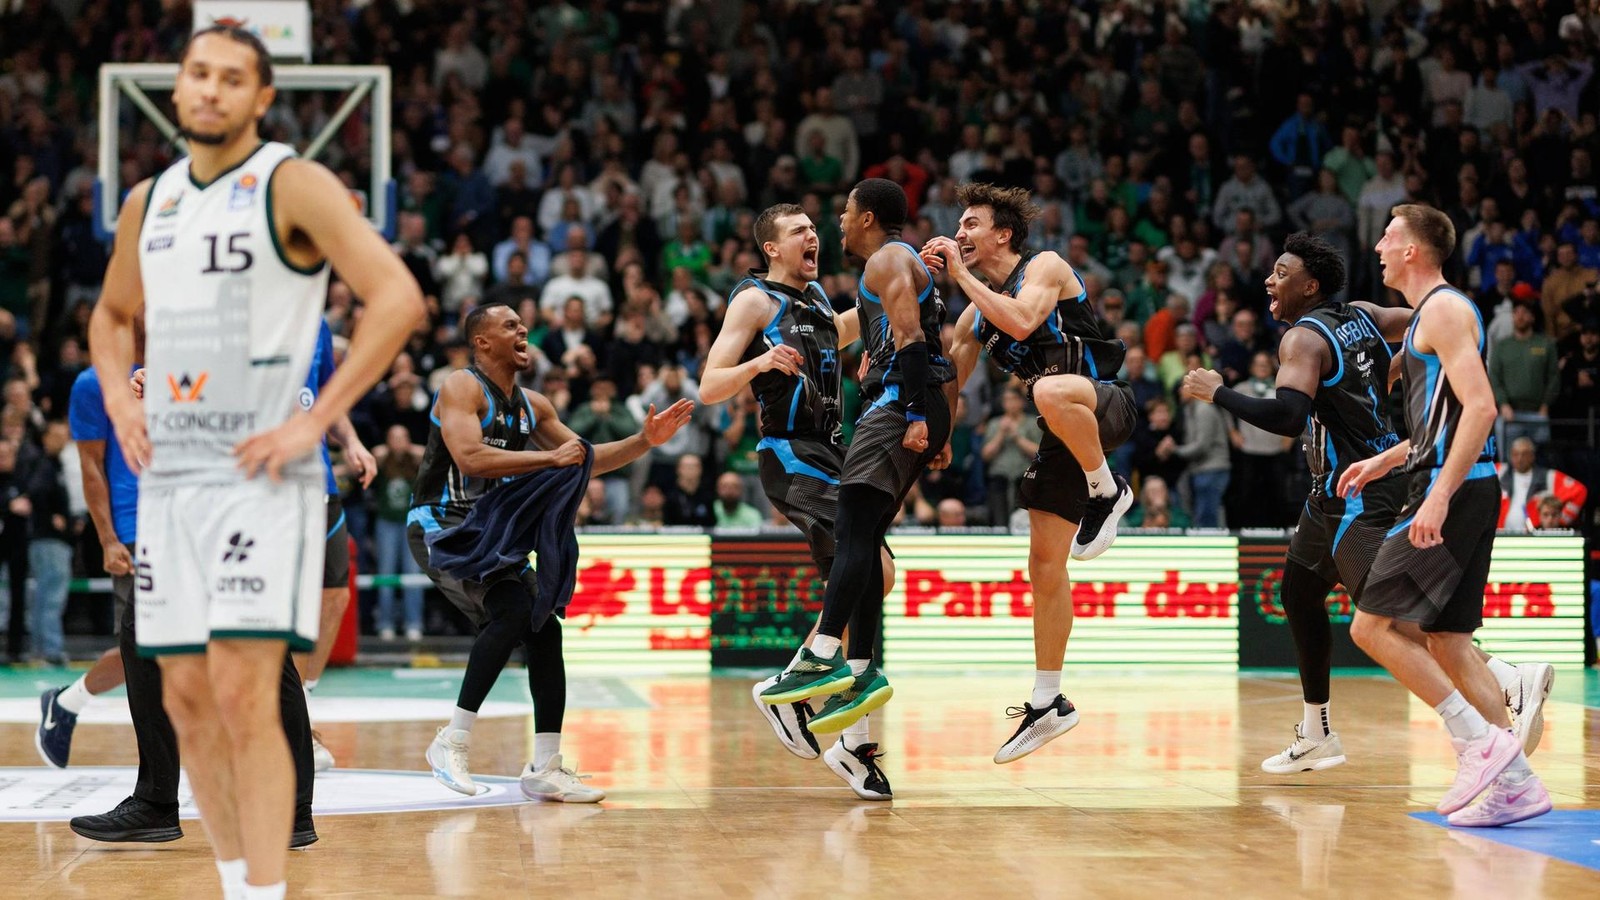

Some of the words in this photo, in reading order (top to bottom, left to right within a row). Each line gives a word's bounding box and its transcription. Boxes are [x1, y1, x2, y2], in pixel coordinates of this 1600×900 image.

[201, 232, 254, 273] 15
[904, 570, 1128, 617] Parter
[1144, 570, 1240, 617] der
